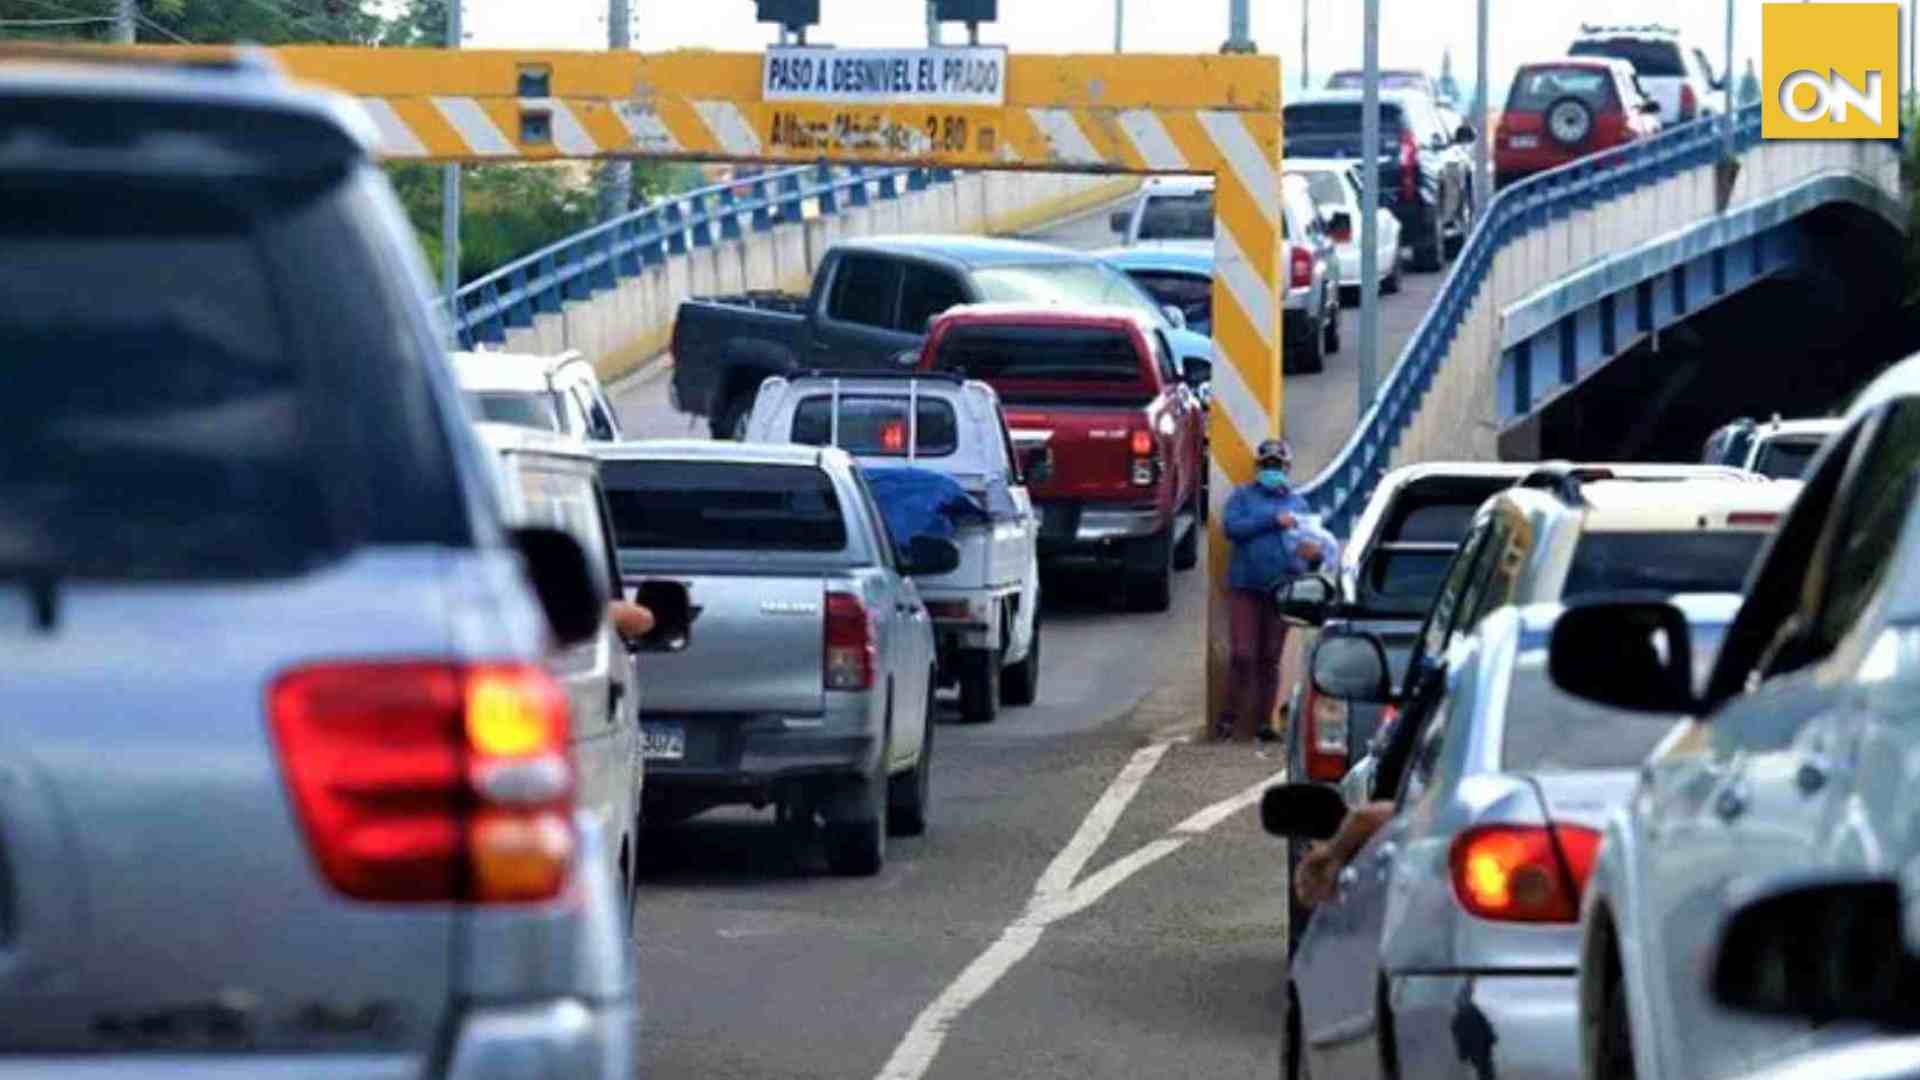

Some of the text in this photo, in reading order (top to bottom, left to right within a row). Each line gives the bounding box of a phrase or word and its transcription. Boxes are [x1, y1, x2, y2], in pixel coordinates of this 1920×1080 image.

[768, 56, 999, 93] PASO A DESNIVEL EL PRADO
